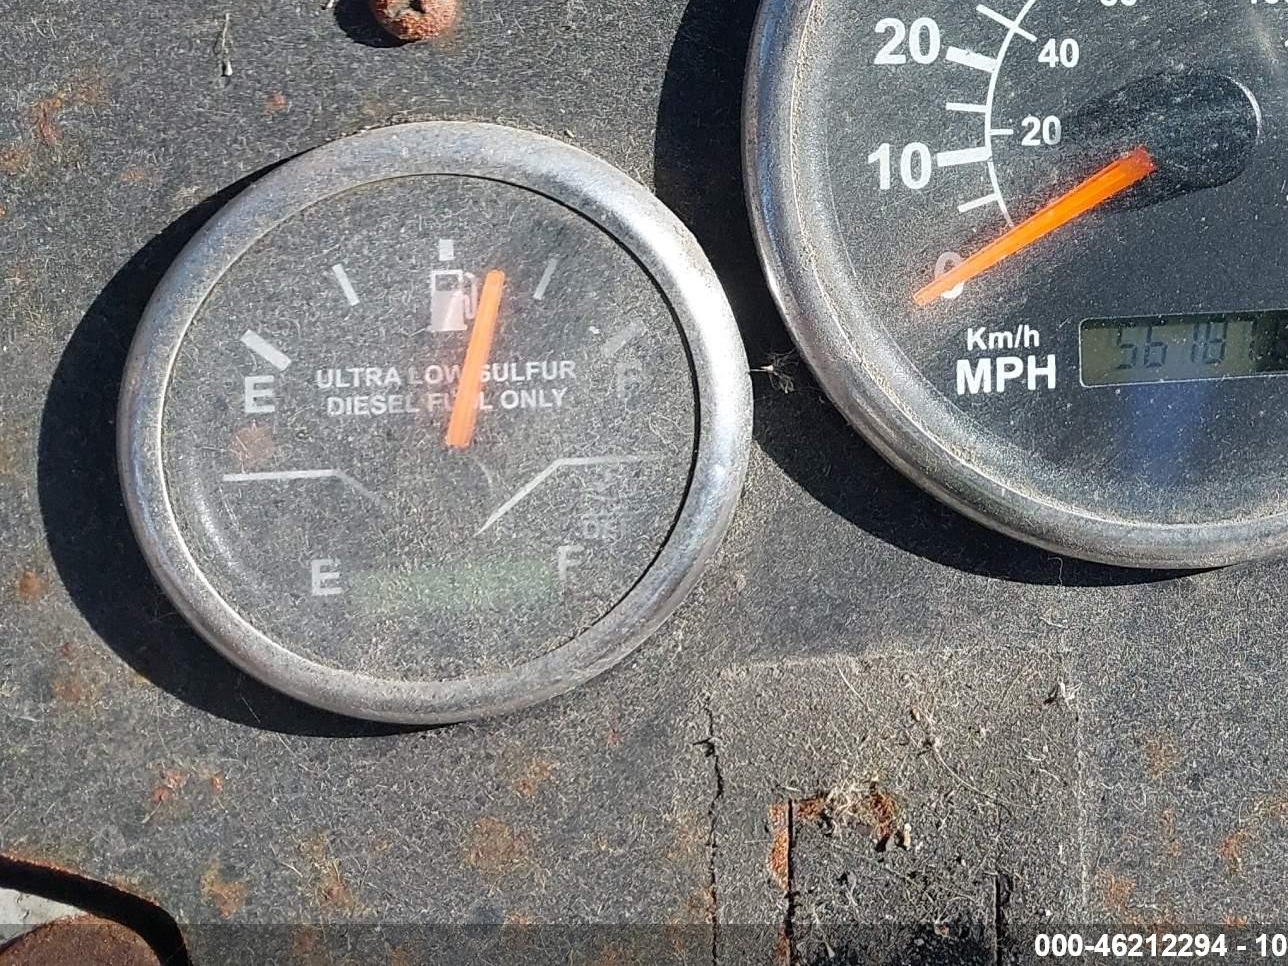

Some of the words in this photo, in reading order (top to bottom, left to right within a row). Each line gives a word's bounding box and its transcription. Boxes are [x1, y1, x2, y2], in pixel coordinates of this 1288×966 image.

[874, 18, 940, 65] 20
[1038, 39, 1080, 68] 40
[1021, 117, 1062, 146] 20
[867, 144, 932, 189] 10
[966, 325, 1039, 351] Km/h
[316, 366, 401, 389] ULTRA
[408, 364, 462, 384] LOW
[479, 359, 577, 383] SULFUR
[955, 355, 1056, 395] MPH
[244, 375, 276, 414] E
[327, 394, 419, 416] DIESEL
[428, 391, 494, 412] FUL
[500, 385, 568, 409] ONLY
[311, 559, 342, 596] E
[558, 545, 585, 582] F
